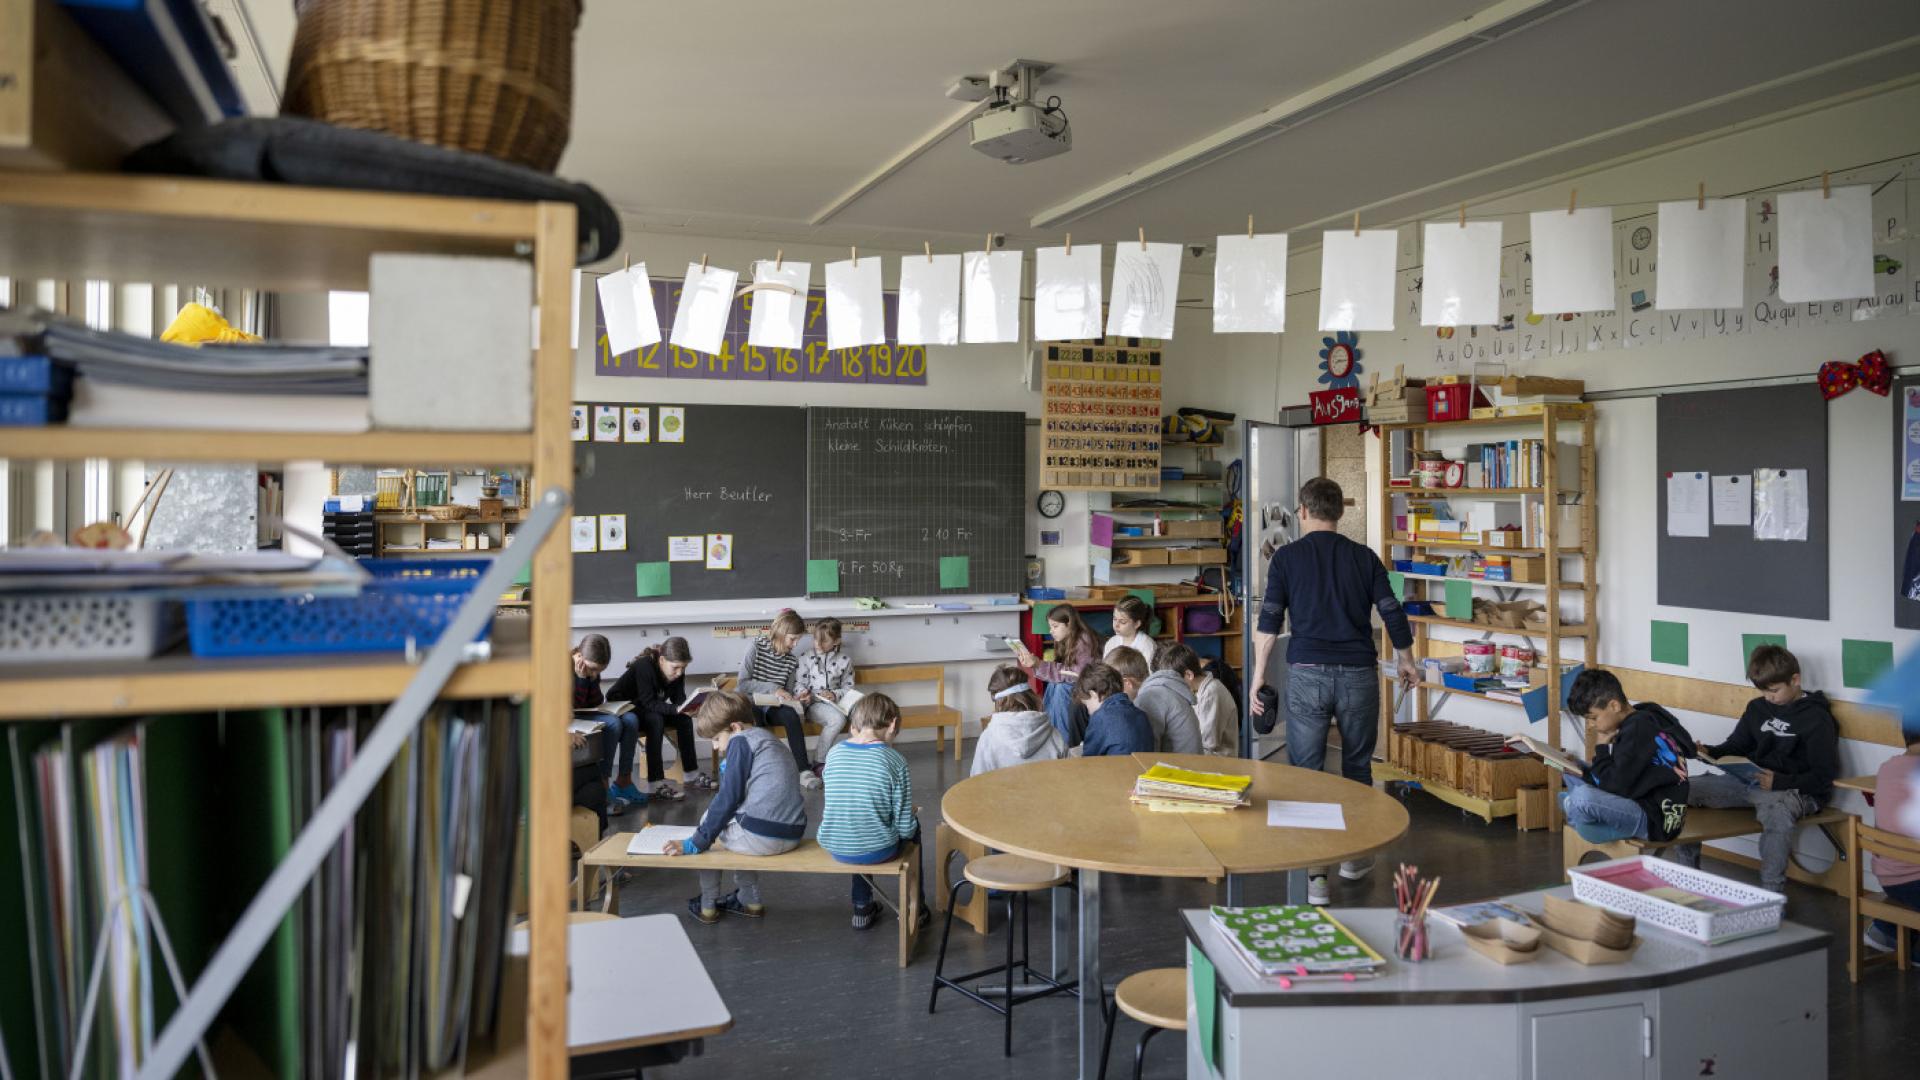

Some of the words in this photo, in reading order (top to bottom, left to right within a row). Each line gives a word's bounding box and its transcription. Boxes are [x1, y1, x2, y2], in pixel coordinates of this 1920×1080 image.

[1758, 232, 1772, 252] H
[1629, 257, 1641, 276] U
[1885, 293, 1904, 305] au
[807, 295, 825, 329] 7
[1754, 301, 1777, 323] Qu
[1779, 305, 1796, 327] qu
[1629, 319, 1640, 338] C
[1669, 313, 1681, 333] V
[1524, 334, 1533, 352] Z
[1592, 324, 1603, 343] X
[804, 340, 830, 375] 17
[866, 343, 892, 377] 19
[895, 343, 926, 377] 20
[683, 486, 713, 501] Herr
[719, 485, 773, 502] Beutler
[851, 560, 865, 574] Fr
